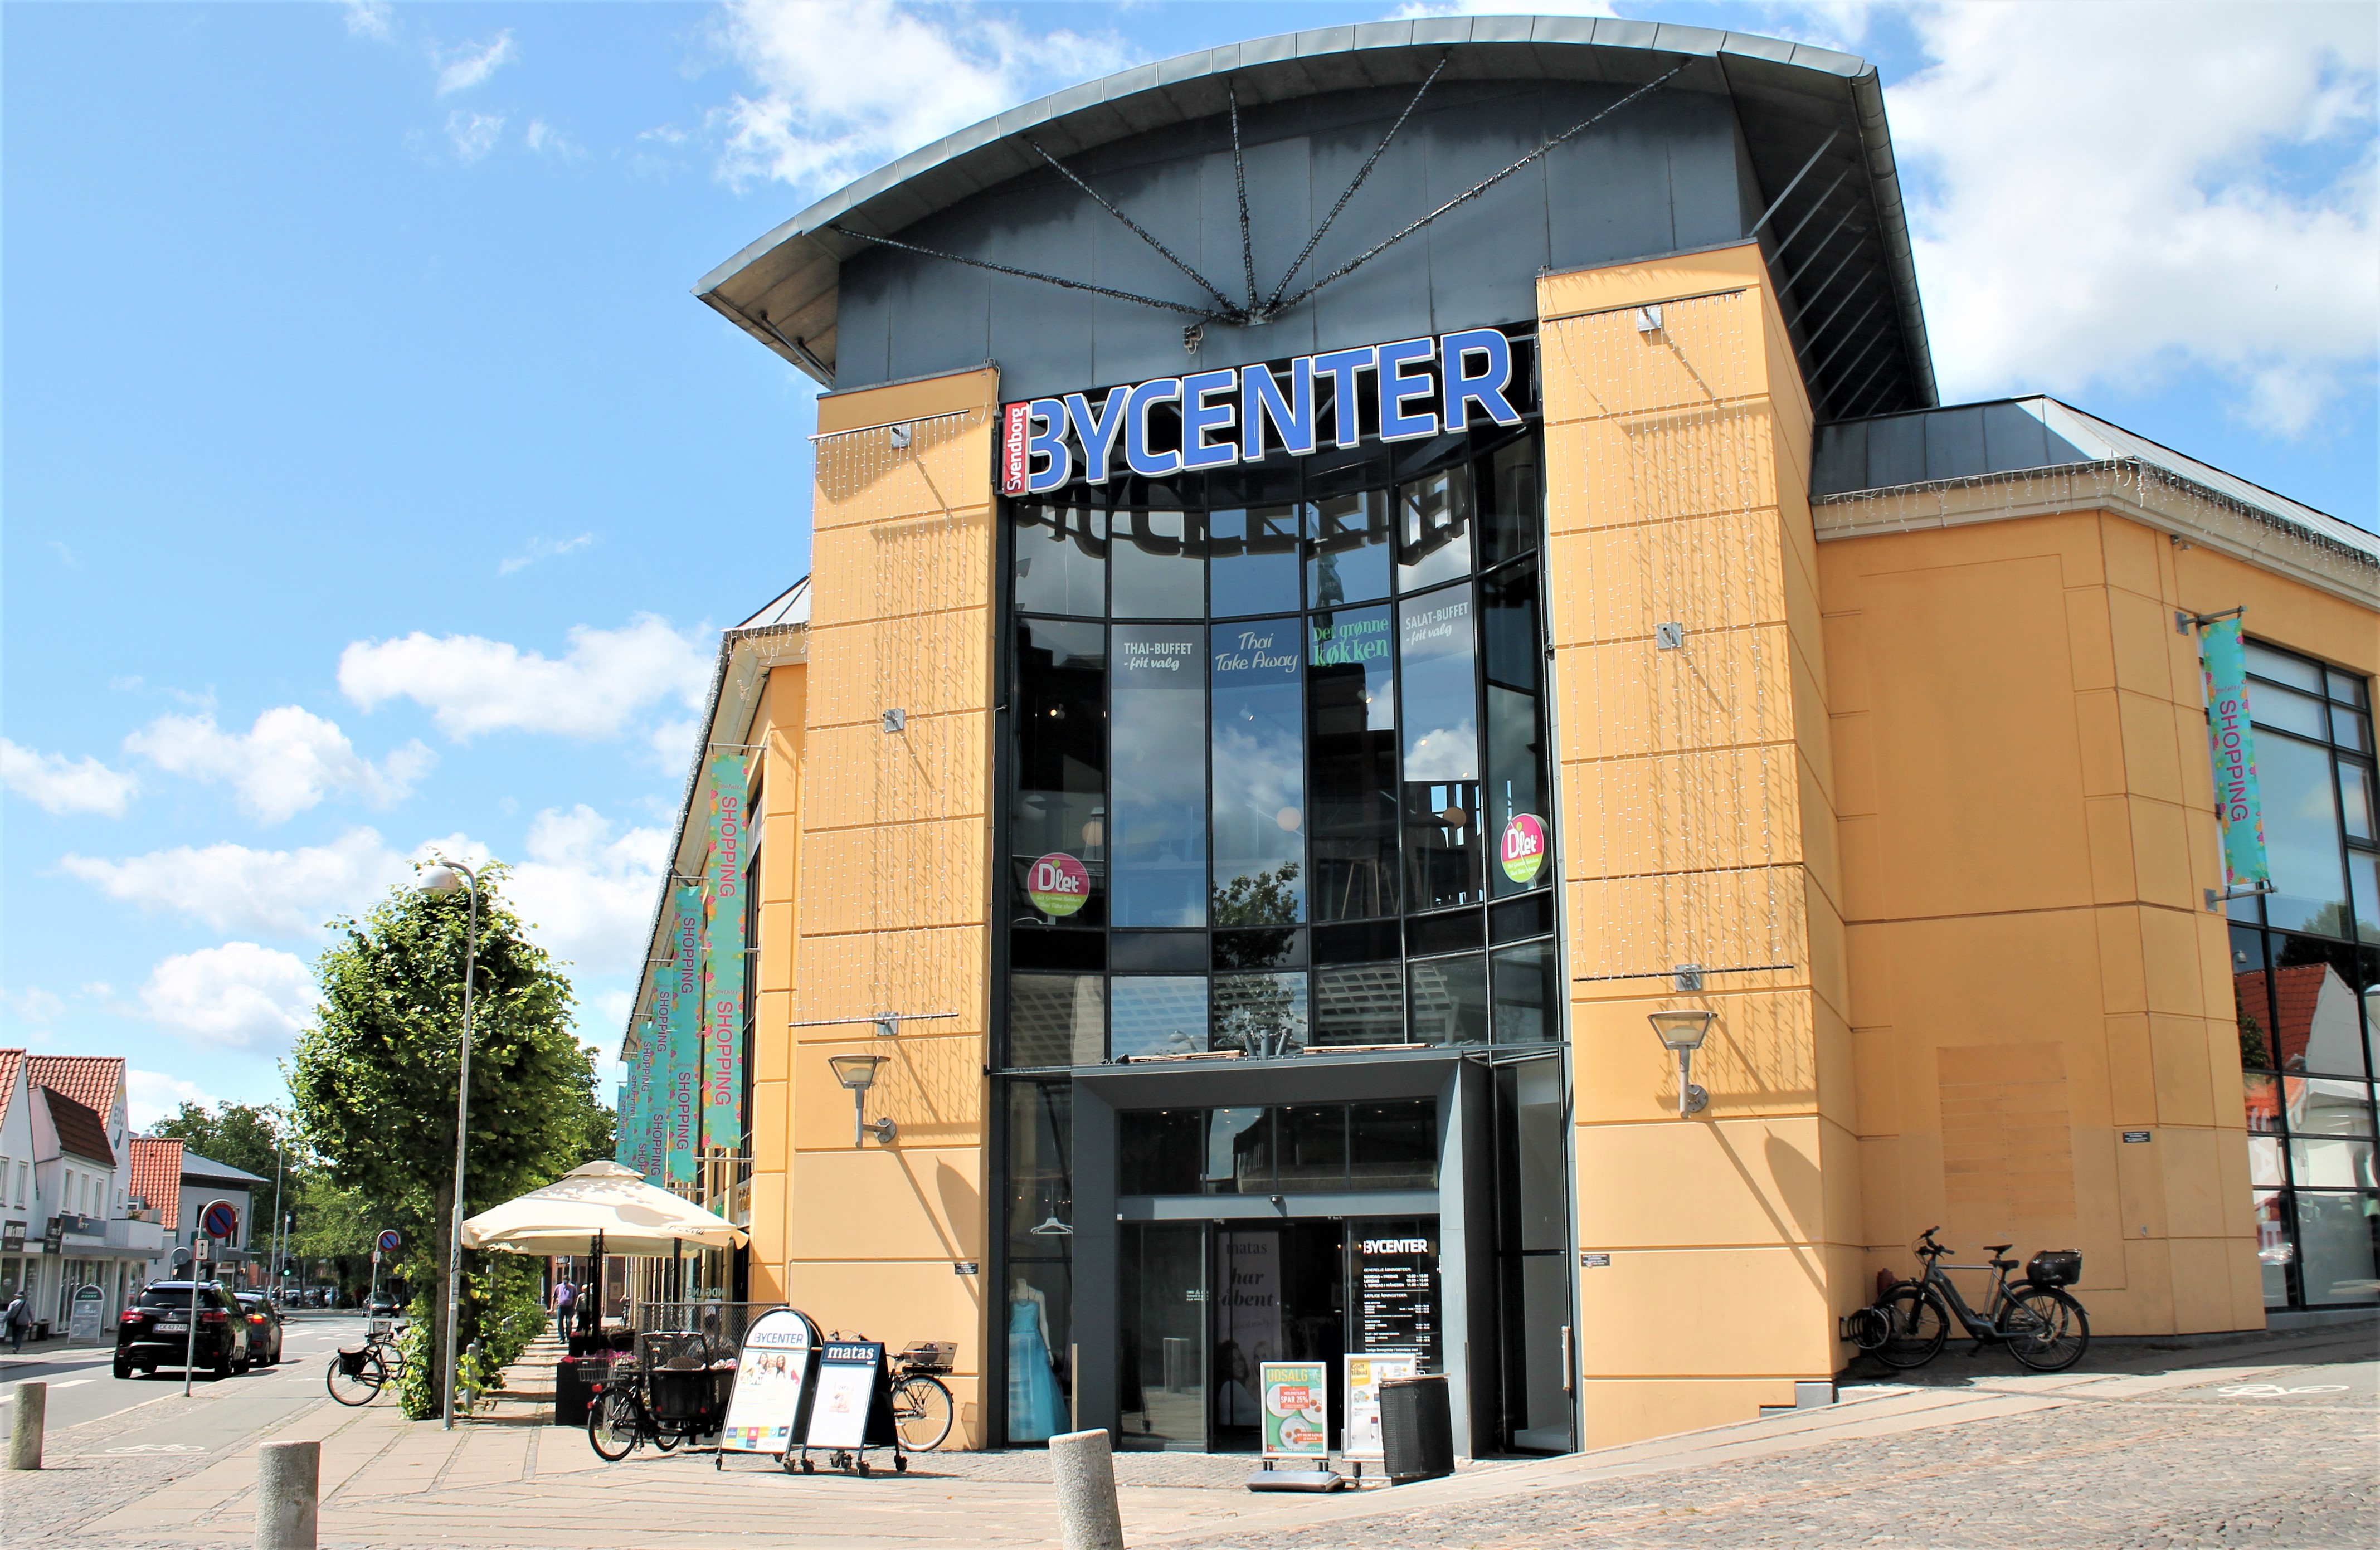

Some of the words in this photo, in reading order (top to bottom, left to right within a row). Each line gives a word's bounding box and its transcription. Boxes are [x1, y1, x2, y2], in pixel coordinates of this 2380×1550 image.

[1029, 328, 1522, 494] BYCENTER
[1007, 406, 1027, 491] Svendborg
[1405, 602, 1469, 630] SALAT-BUFFET
[1238, 632, 1274, 650] Thai
[1313, 624, 1336, 642] Det
[1339, 618, 1389, 642] grønne
[1411, 628, 1427, 645] frit
[1428, 623, 1453, 638] valg
[1123, 642, 1193, 655] THAI-BUFFET
[1313, 638, 1389, 667] køkken
[1130, 656, 1148, 671] frit
[1151, 656, 1180, 671] valg
[1215, 652, 1249, 671] Take
[1252, 651, 1298, 673] Away
[2218, 699, 2249, 823] SHOPPING
[719, 796, 738, 897] SHOPPING
[680, 917, 695, 994] SHOPPING
[657, 991, 669, 1052] SHOPPING
[714, 1001, 733, 1105] SHOPPING
[641, 1041, 651, 1093] SHOPPING
[676, 1071, 691, 1151] SHOPPING
[650, 1114, 663, 1176] SHOPPING
[637, 1143, 647, 1175] SHOP
[1226, 1242, 1268, 1254] matas
[1365, 1239, 1428, 1254] BYCENTER
[1232, 1268, 1264, 1284] har
[1221, 1289, 1274, 1307] åbent
[755, 1332, 804, 1344] BYCENTER
[827, 1346, 874, 1359] matas
[1267, 1368, 1308, 1382] UDSALG
[1281, 1396, 1295, 1404] SPAR
